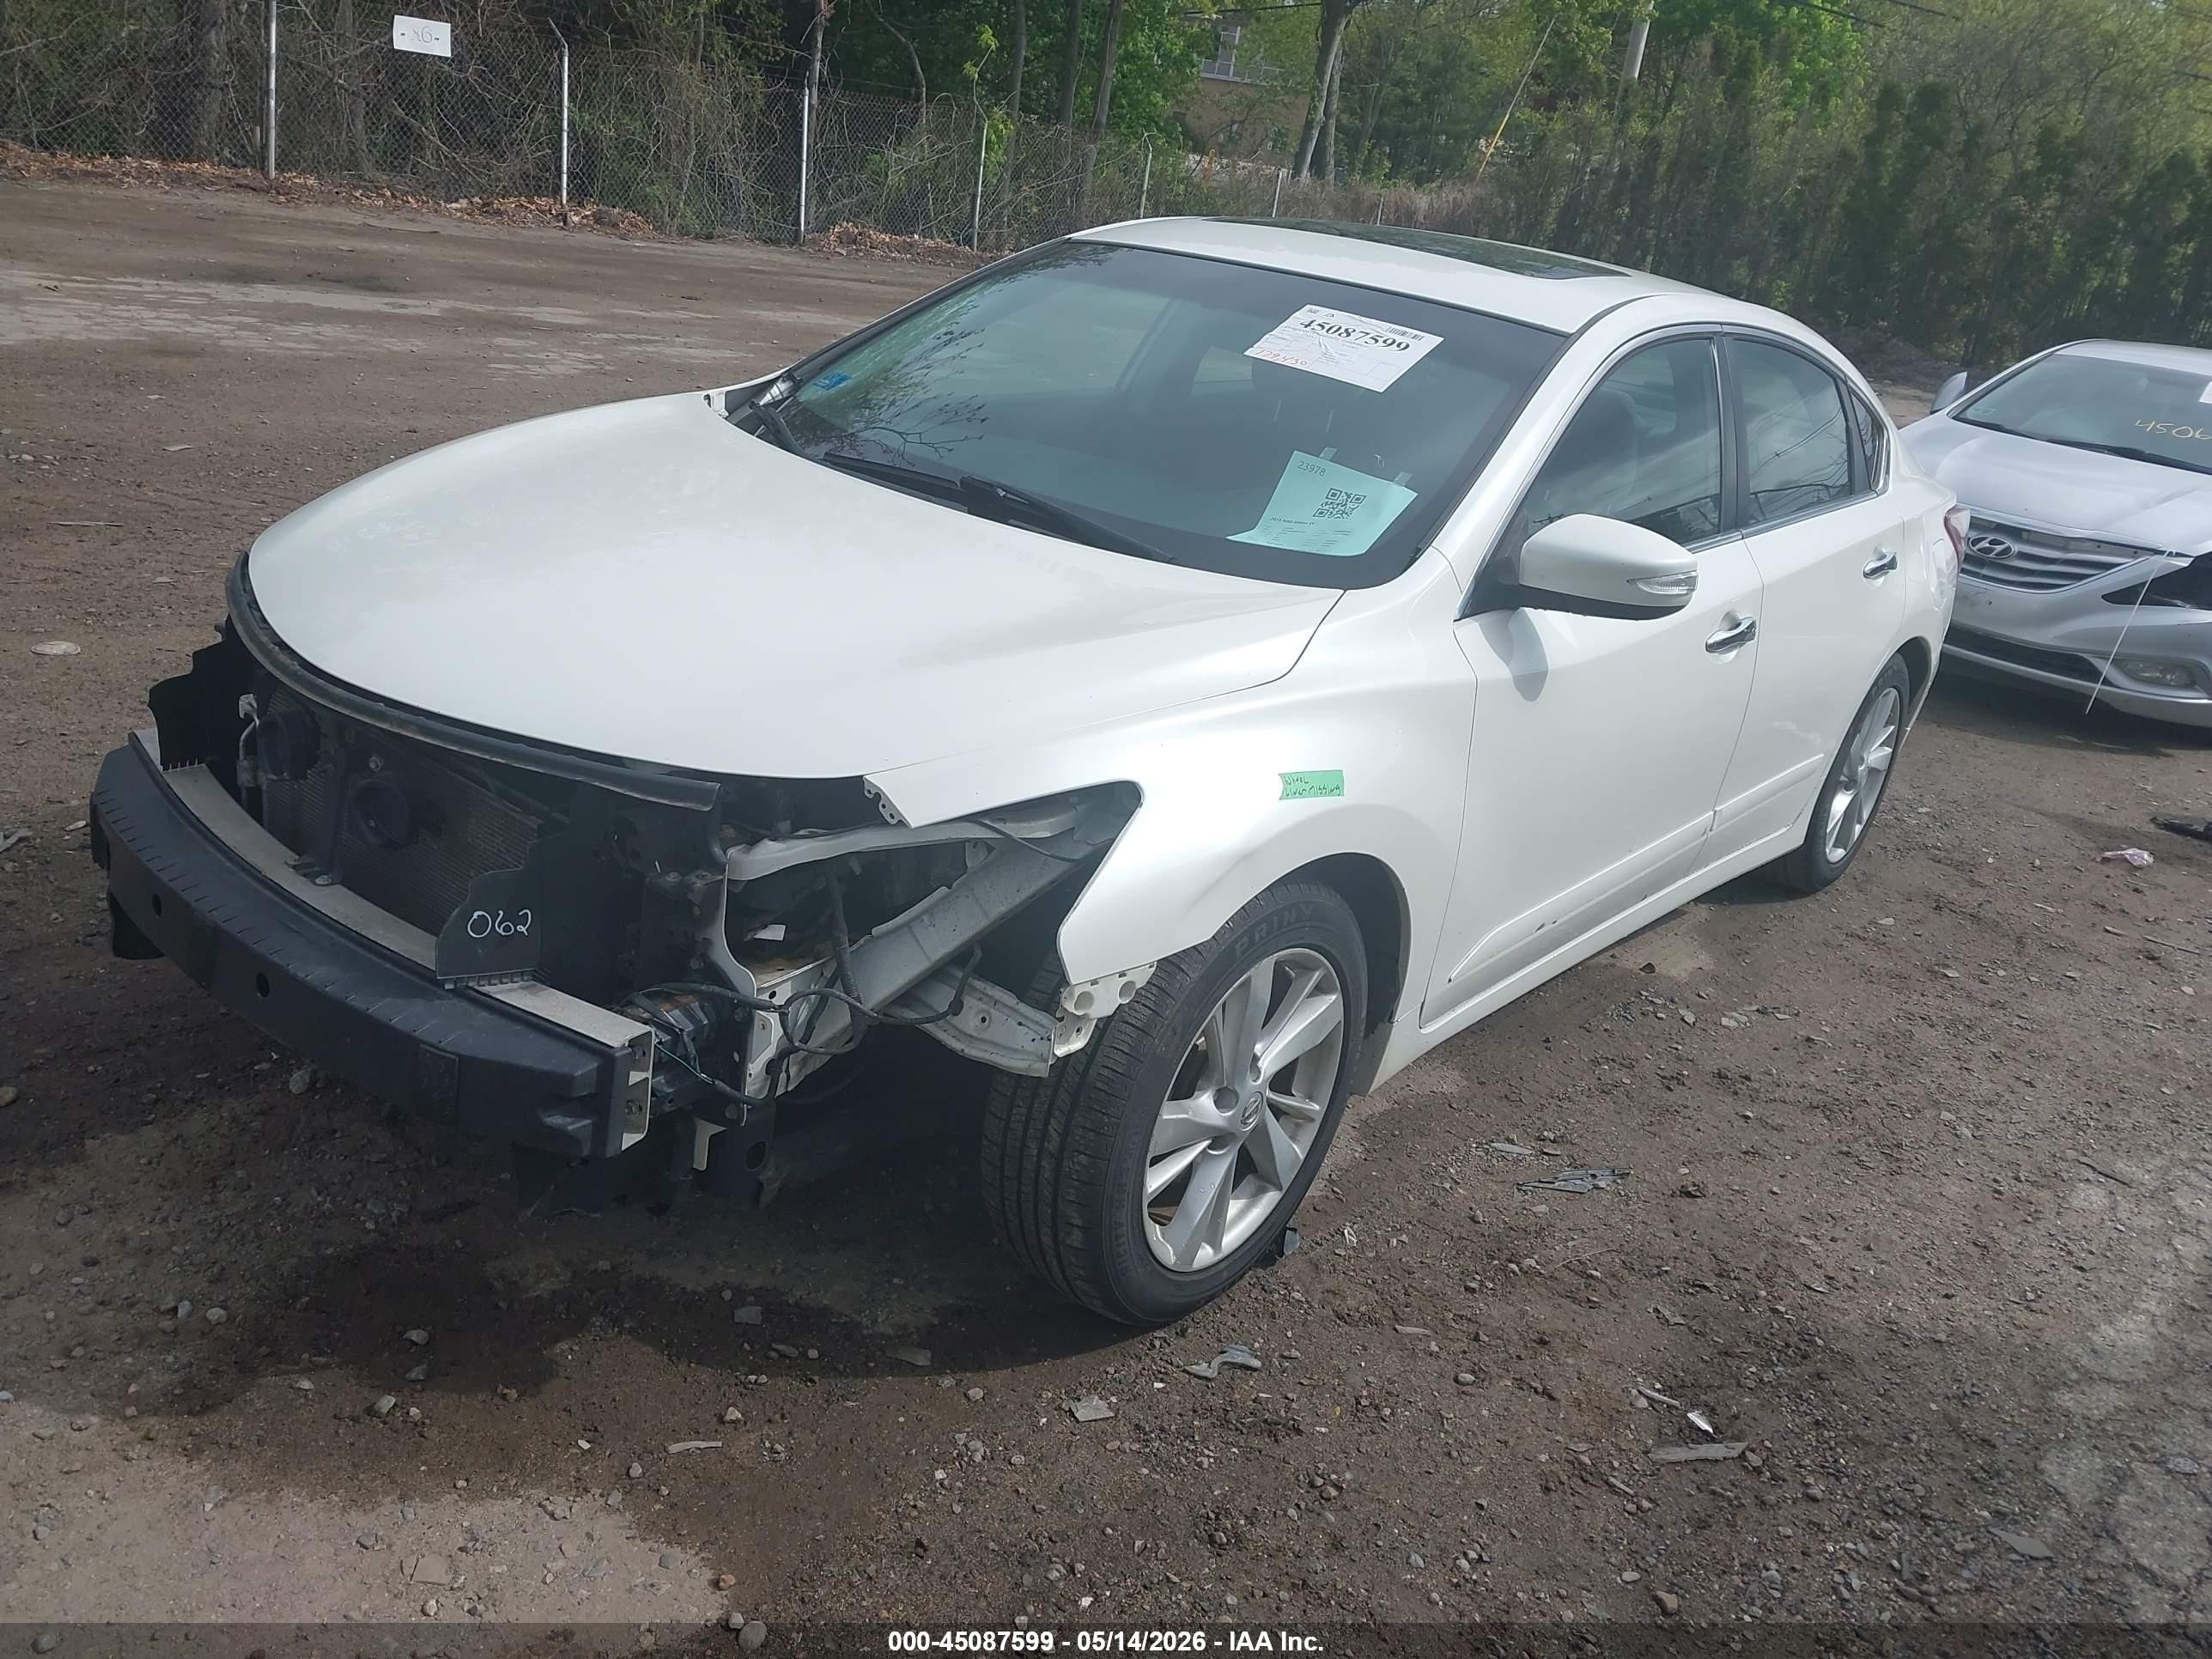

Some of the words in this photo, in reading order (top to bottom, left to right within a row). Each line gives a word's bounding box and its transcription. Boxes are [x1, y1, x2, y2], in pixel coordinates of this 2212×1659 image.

[1299, 319, 1411, 352] 45087599
[1297, 460, 1327, 477] 23978
[467, 908, 532, 938] 062
